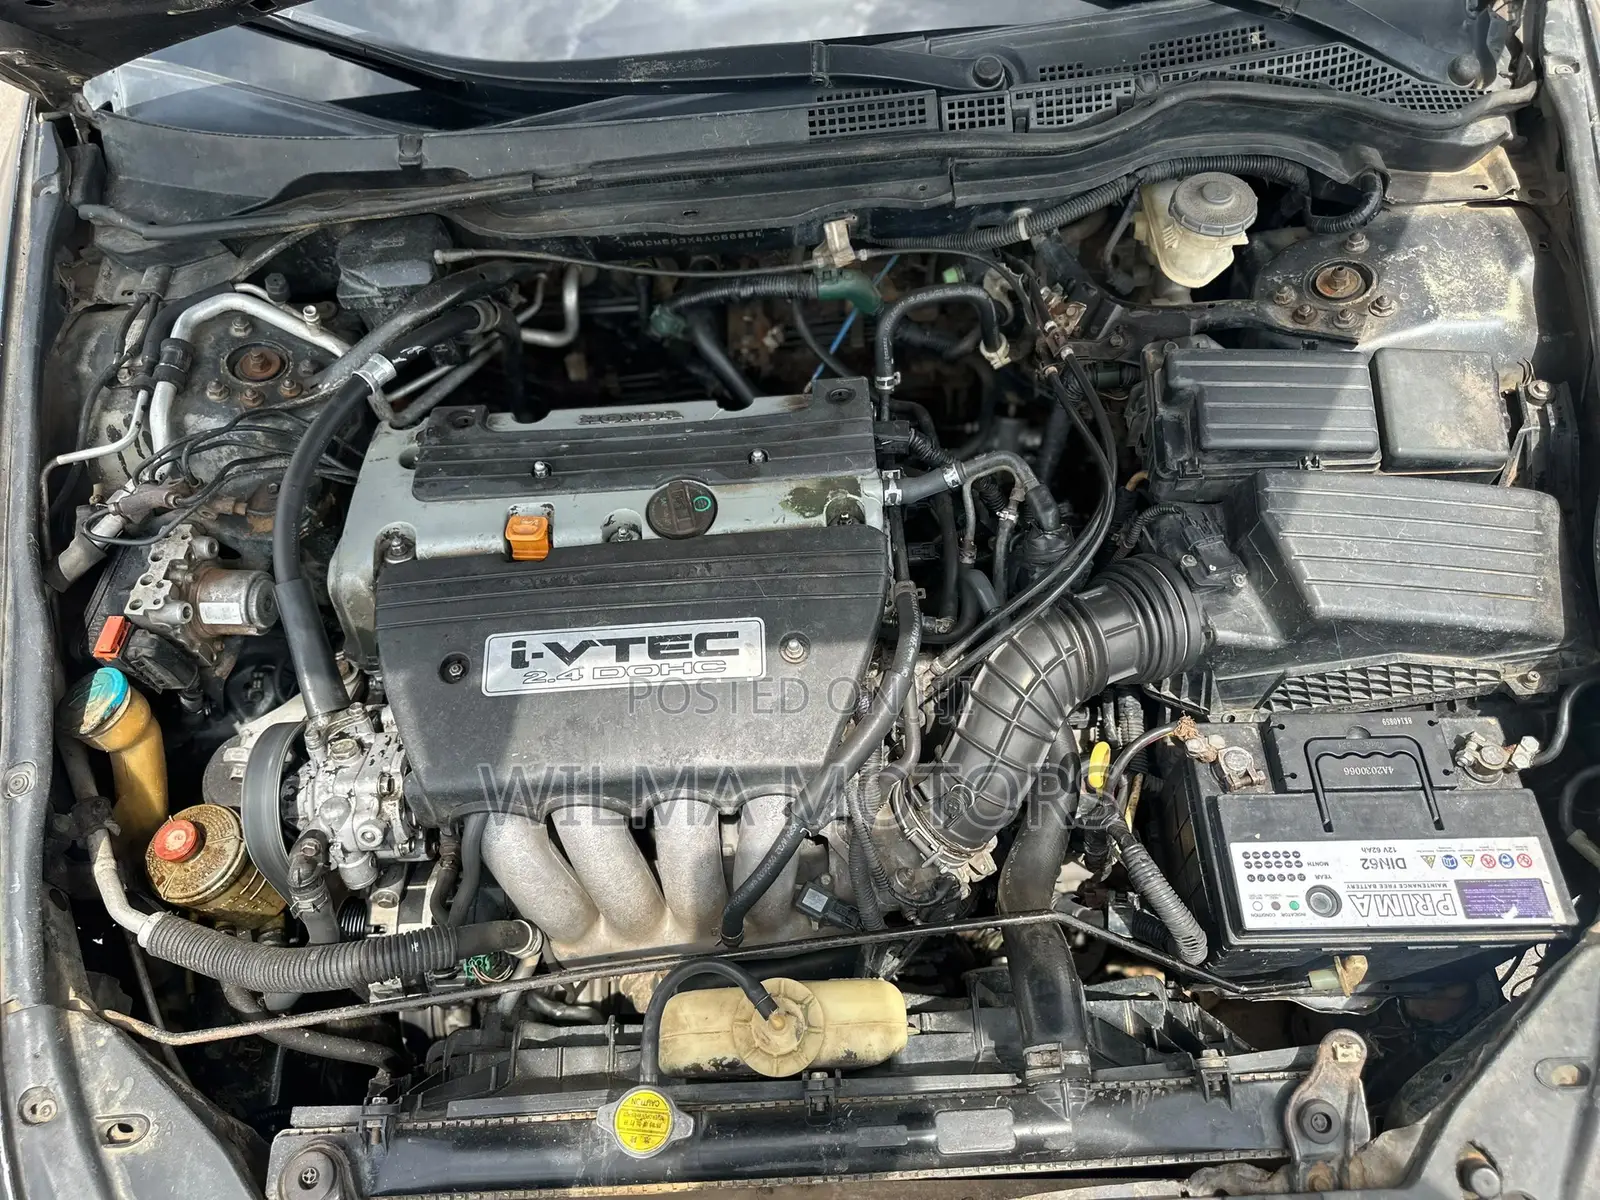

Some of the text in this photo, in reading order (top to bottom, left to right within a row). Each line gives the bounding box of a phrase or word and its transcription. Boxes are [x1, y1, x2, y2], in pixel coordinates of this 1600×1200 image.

[577, 410, 684, 425] HONDA
[510, 631, 740, 670] i-VTEC
[522, 660, 727, 685] 2.4 DOHC
[1359, 857, 1407, 870] DIN62
[1347, 893, 1457, 918] PRIMA
[631, 1097, 660, 1108] CAUTION
